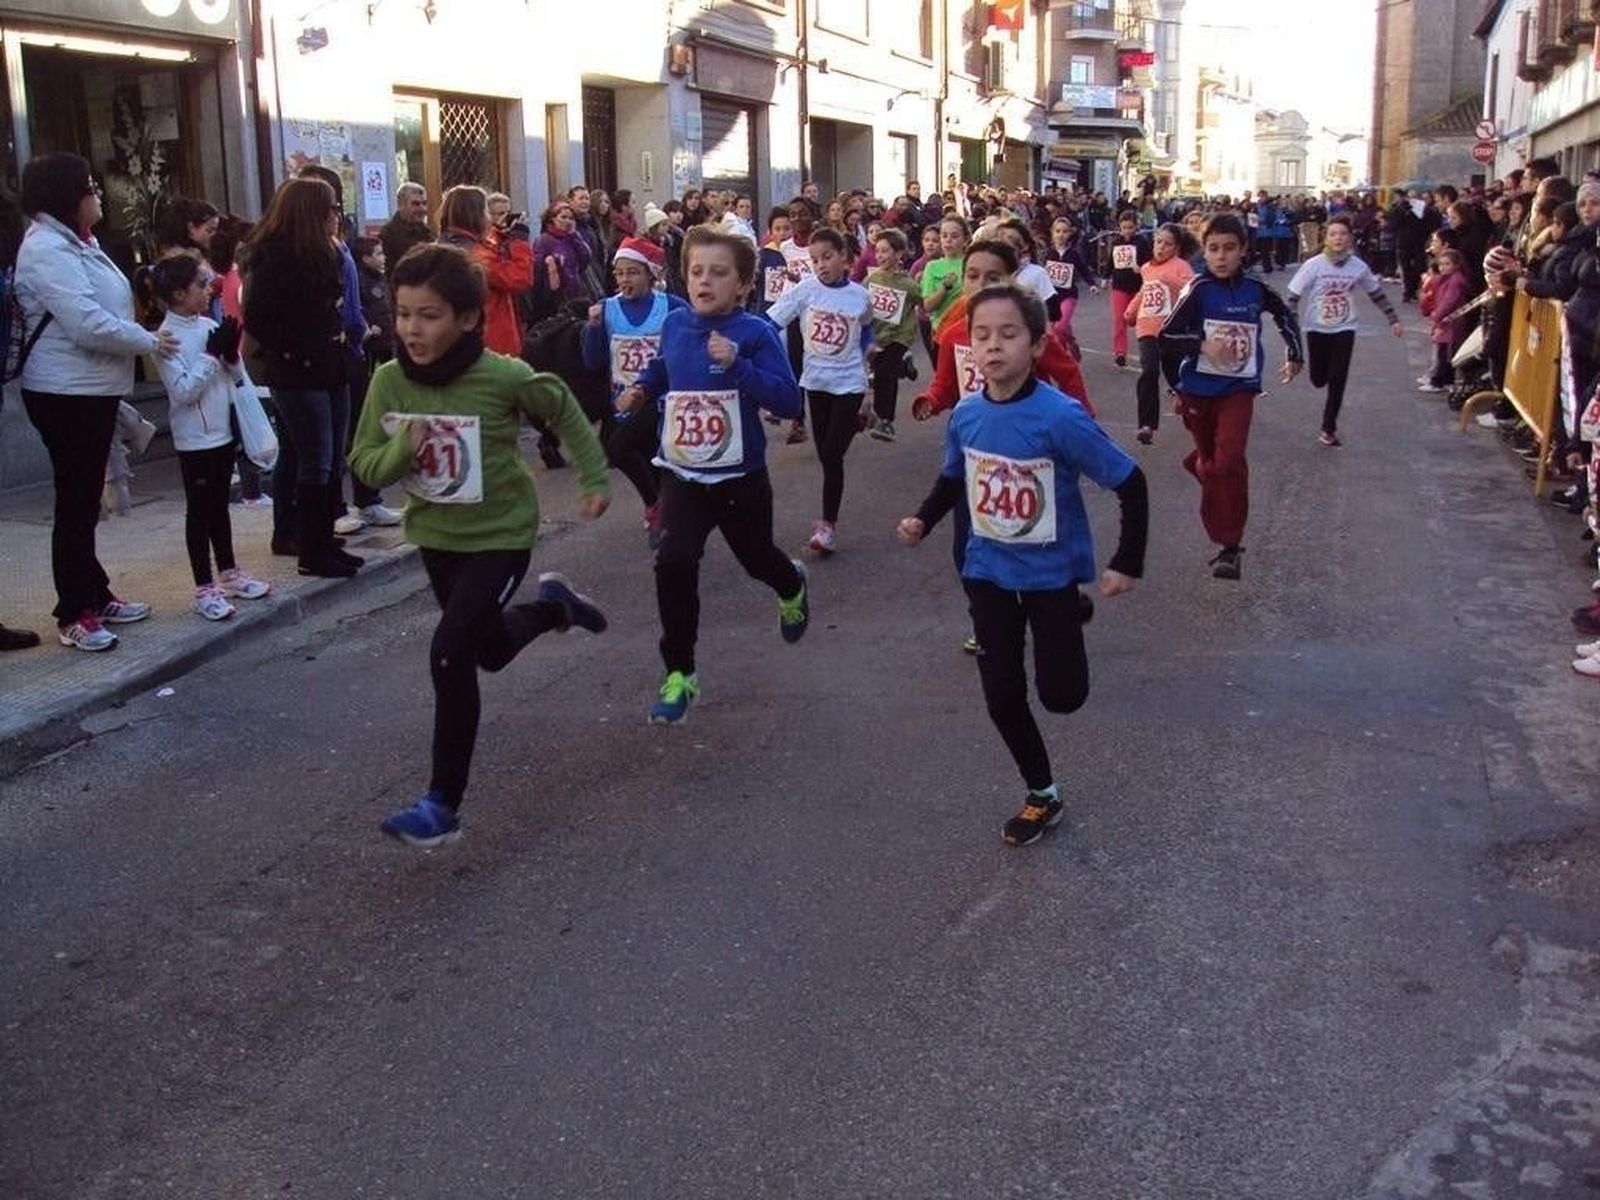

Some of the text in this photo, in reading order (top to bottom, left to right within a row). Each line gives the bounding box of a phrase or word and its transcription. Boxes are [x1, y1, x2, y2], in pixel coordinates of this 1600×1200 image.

[1474, 146, 1493, 157] STOP
[873, 294, 897, 313] 236
[811, 321, 846, 348] 222
[674, 415, 725, 447] 239
[411, 443, 457, 479] 41
[976, 479, 1037, 519] 240
